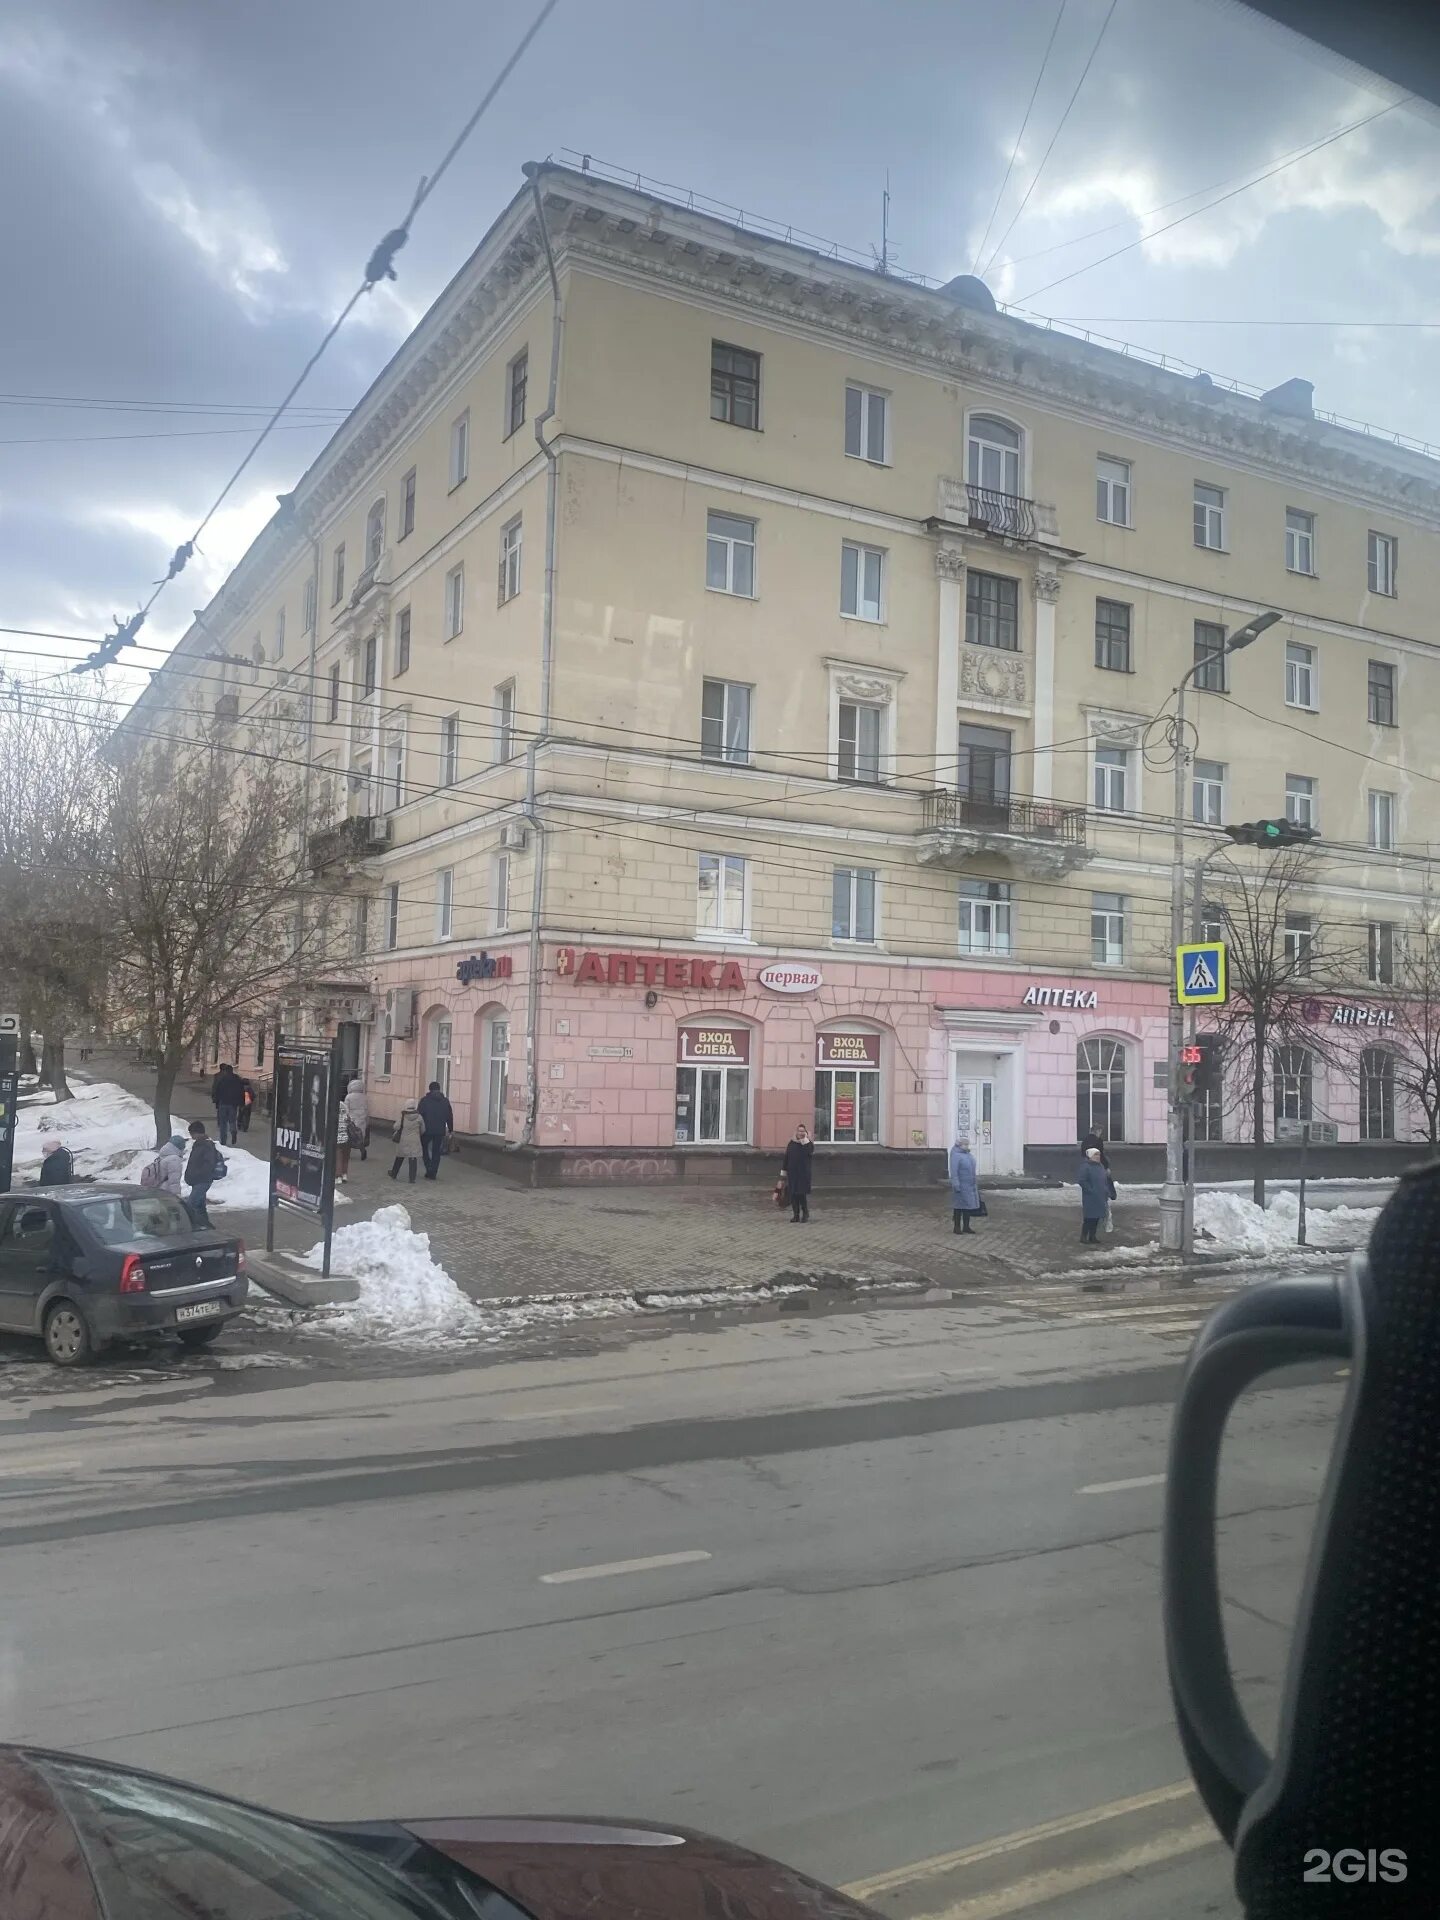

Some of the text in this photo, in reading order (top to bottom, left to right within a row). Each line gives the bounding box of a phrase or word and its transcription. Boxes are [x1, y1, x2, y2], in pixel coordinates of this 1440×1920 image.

[574, 952, 746, 990] АПТЕКА
[765, 972, 819, 987] первая
[1023, 986, 1098, 1009] АПТЕКА
[698, 1032, 733, 1044] ВХОД
[833, 1037, 865, 1049] ВХОД
[694, 1043, 737, 1056] СЛЕВА
[829, 1048, 868, 1060] СЛЕВА
[276, 1127, 300, 1151] КРУГ
